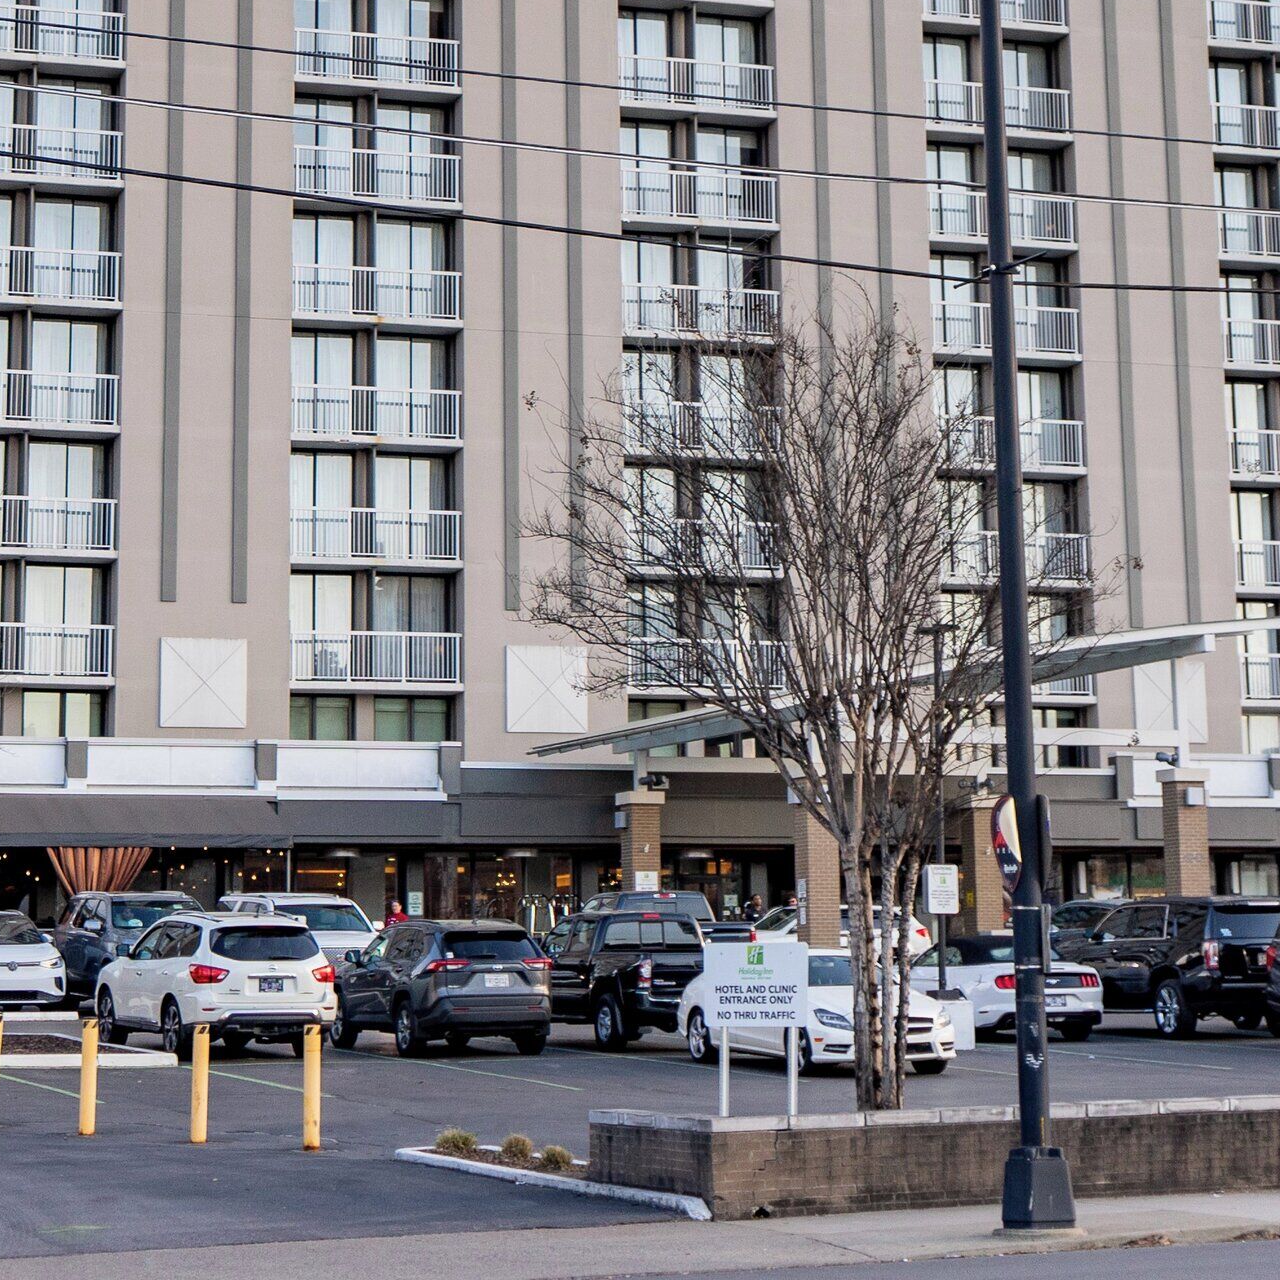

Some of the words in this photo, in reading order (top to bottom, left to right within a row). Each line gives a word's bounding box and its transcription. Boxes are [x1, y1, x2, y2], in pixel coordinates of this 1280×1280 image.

[738, 967, 762, 977] Holiday
[715, 985, 744, 994] HOTEL
[746, 985, 766, 994] AND
[768, 985, 798, 993] CLINIC
[719, 996, 767, 1004] ENTRANCE
[769, 996, 793, 1004] ONLY
[717, 1011, 731, 1020] NO
[734, 1011, 757, 1020] THRU
[760, 1011, 796, 1019] TRAFFIC
